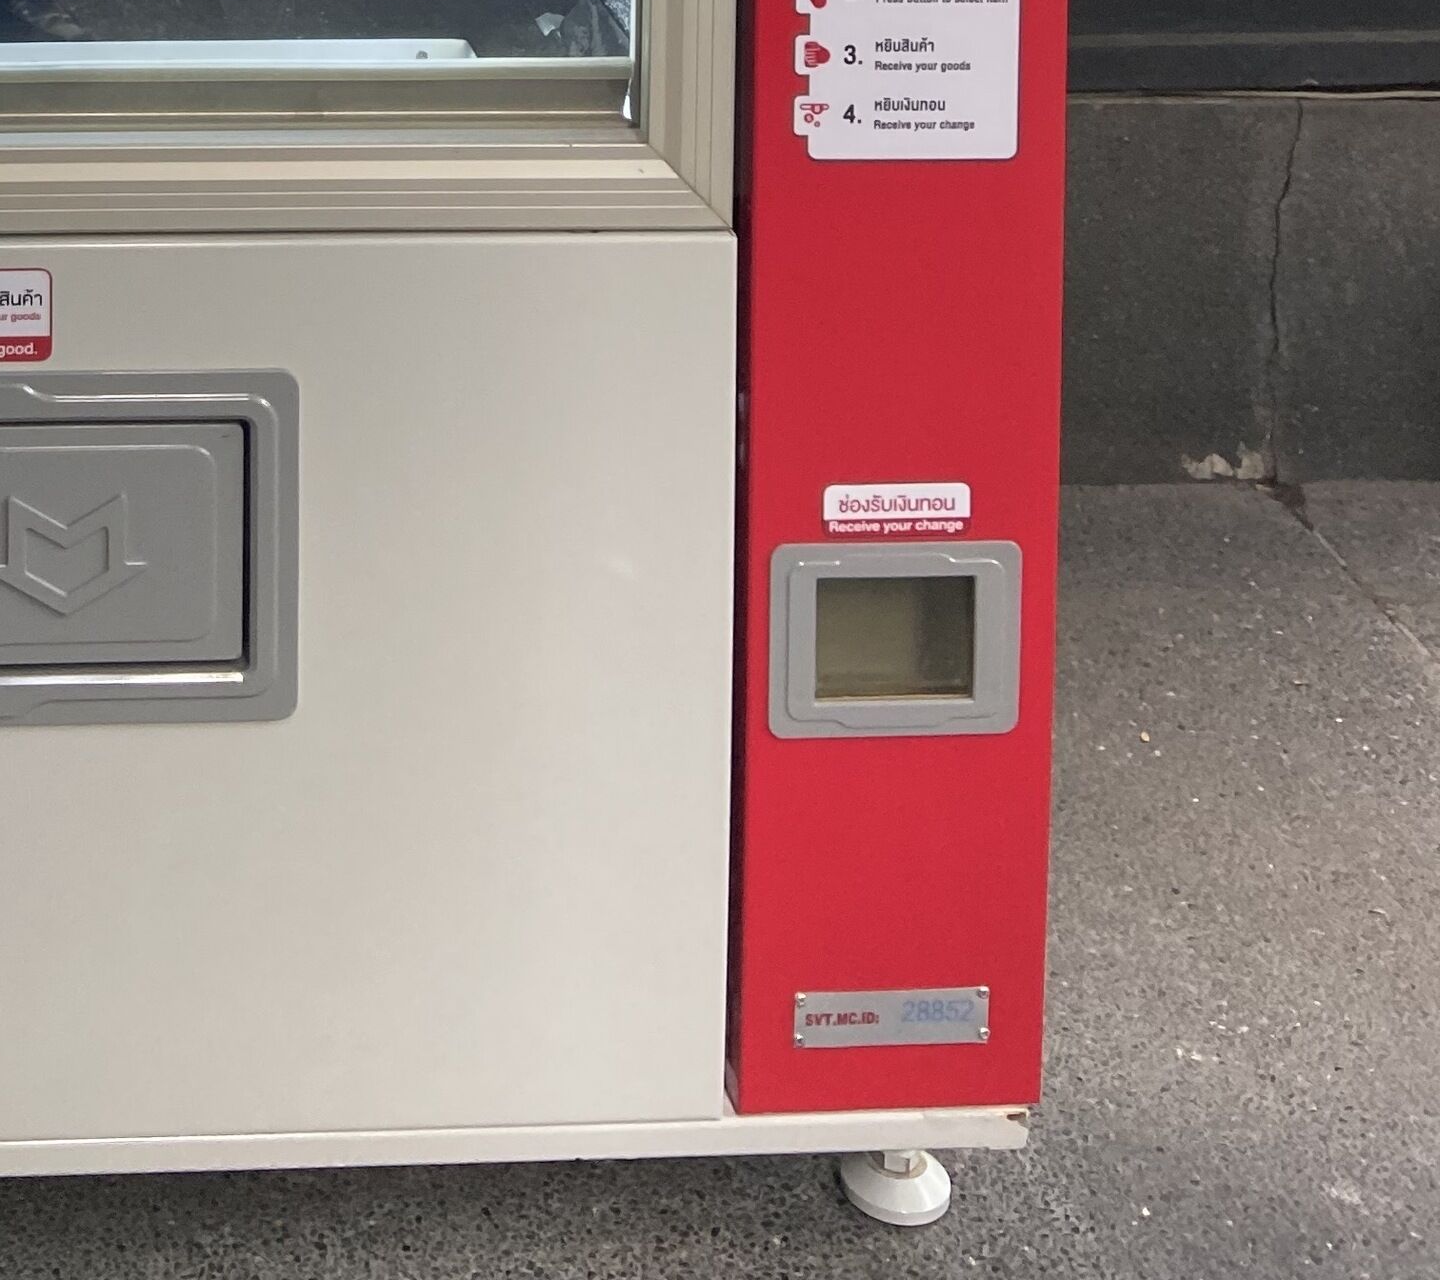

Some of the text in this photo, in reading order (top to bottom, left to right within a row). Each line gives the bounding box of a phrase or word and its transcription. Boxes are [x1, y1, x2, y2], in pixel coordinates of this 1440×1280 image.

[875, 38, 935, 53] หยิบสินค้า
[843, 45, 863, 65] 3.
[875, 61, 971, 73] Receive your goods
[874, 97, 945, 112] หยิบเงินทอน
[843, 104, 862, 124] 4.
[873, 120, 975, 132] Receive your change
[10, 312, 42, 322] goods
[838, 493, 956, 513] ช่องรับเงินทอน
[829, 519, 964, 534] Receive your change
[805, 998, 975, 1026] SVT.MC.ID: 28852
